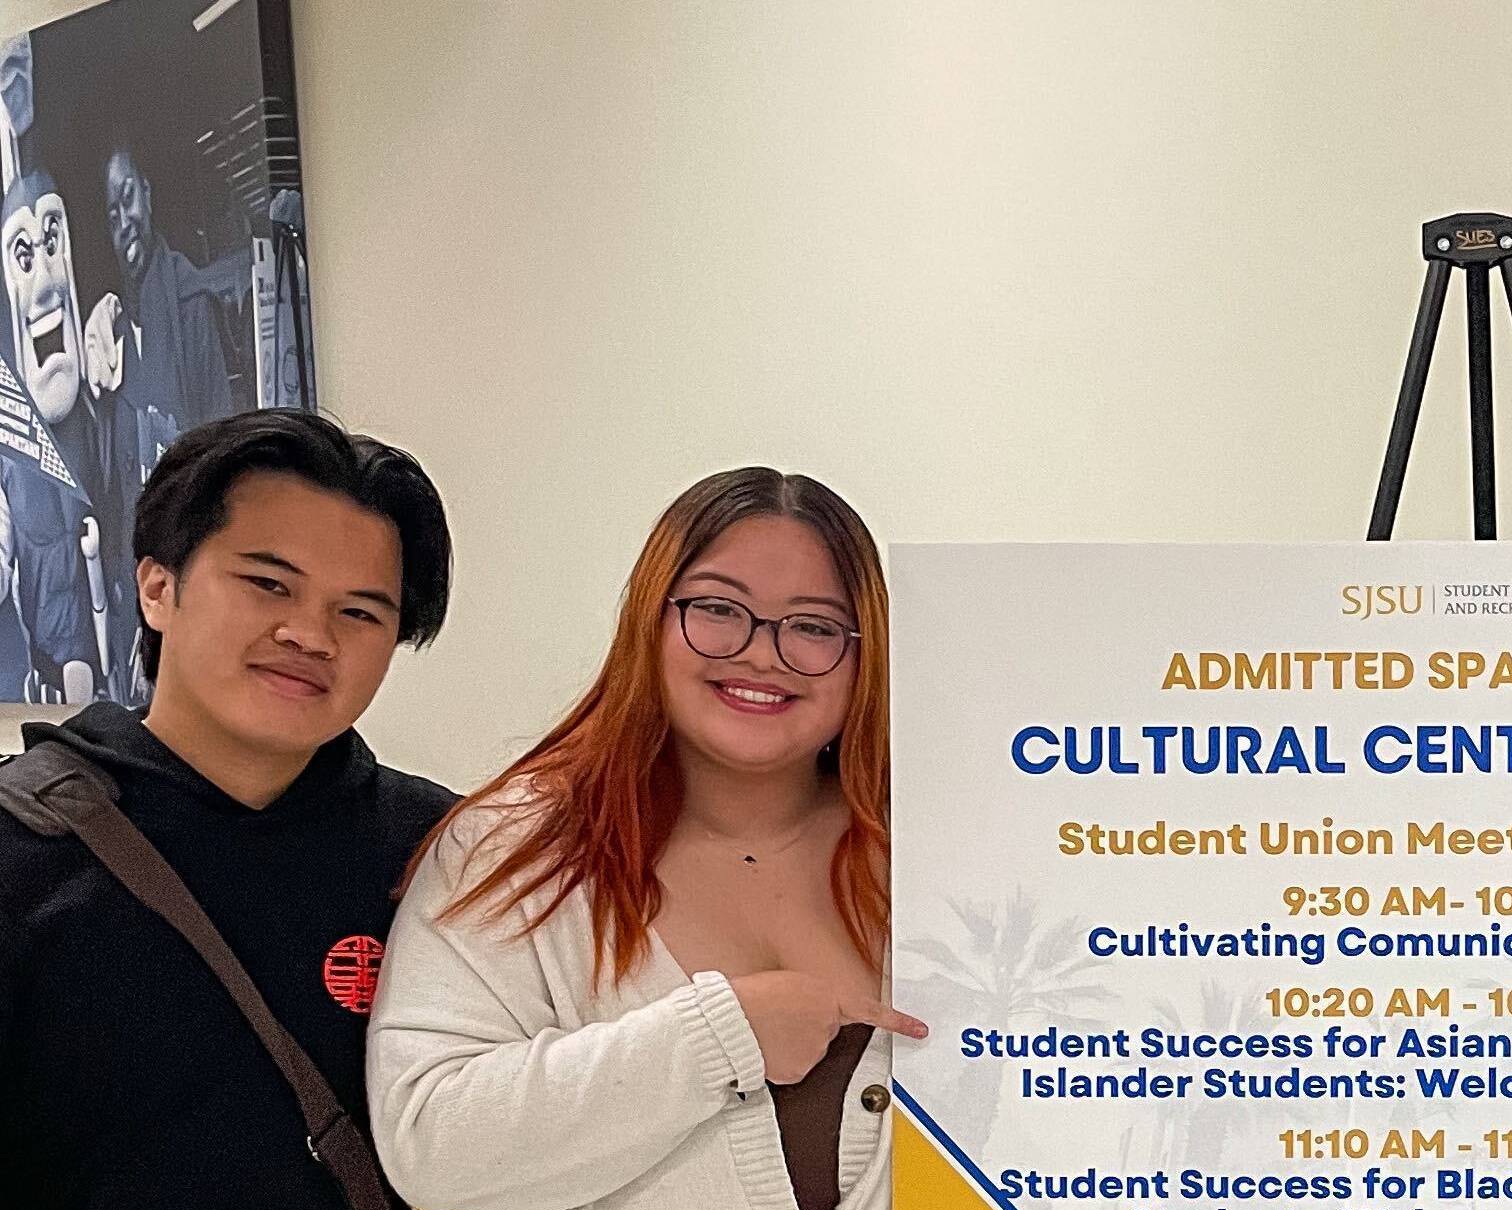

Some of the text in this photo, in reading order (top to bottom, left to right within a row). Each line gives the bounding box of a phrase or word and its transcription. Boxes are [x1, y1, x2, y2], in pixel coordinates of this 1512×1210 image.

[1342, 585, 1423, 620] SJSU
[1444, 584, 1511, 597] STUDENT
[1444, 602, 1478, 615] AND
[1162, 652, 1414, 690] ADMITTED
[1012, 726, 1345, 775] CULTURAL
[1059, 821, 1246, 856] Student
[1260, 818, 1393, 855] Union
[1283, 887, 1370, 917] 9:30
[1088, 923, 1325, 965] Cultivating
[1266, 988, 1374, 1018] 10:20
[1385, 989, 1450, 1017] AM
[961, 1027, 1129, 1058] Student
[1141, 1028, 1313, 1058] Success
[1324, 1026, 1386, 1058] for
[1396, 1024, 1511, 1058] Asian
[1022, 1068, 1192, 1098] Islander
[1204, 1068, 1406, 1099] Students:
[1279, 1130, 1369, 1159] 11:10
[1380, 1130, 1445, 1159] AM
[1000, 1169, 1169, 1200] Student
[1180, 1169, 1352, 1199] Success
[1363, 1168, 1425, 1199] for
